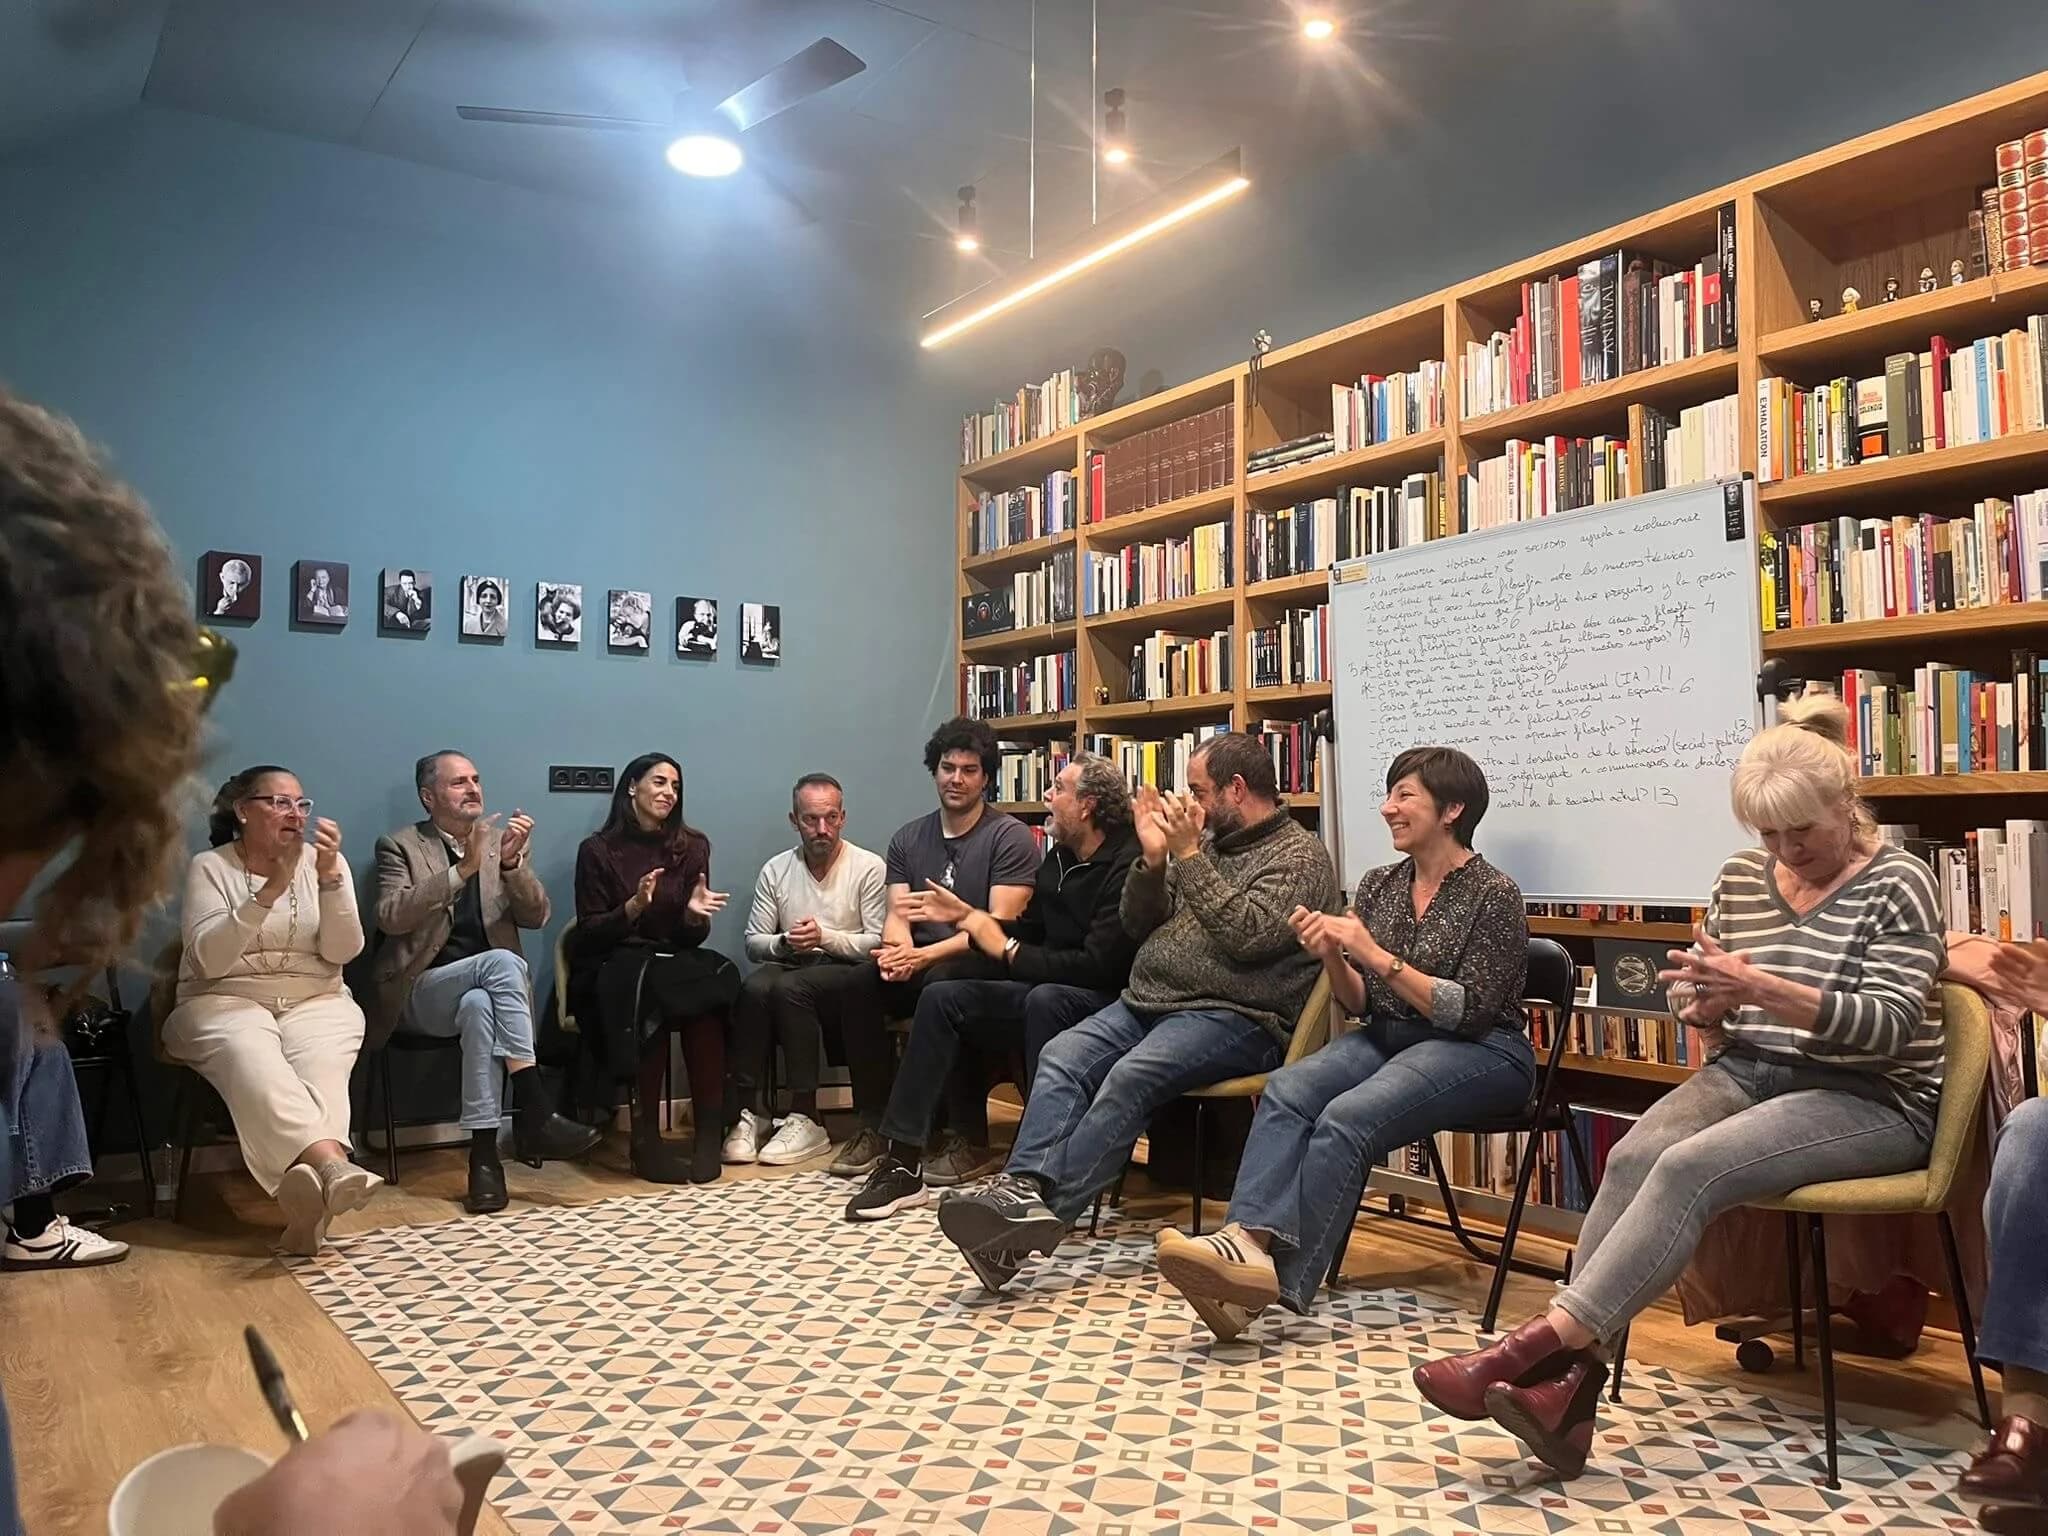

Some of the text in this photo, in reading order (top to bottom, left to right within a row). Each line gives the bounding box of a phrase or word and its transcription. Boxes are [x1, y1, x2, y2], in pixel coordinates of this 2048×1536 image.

[1602, 280, 1614, 353] ANIMAL
[1975, 343, 1987, 382] HAMLET
[1760, 396, 1768, 458] EXHALATION
